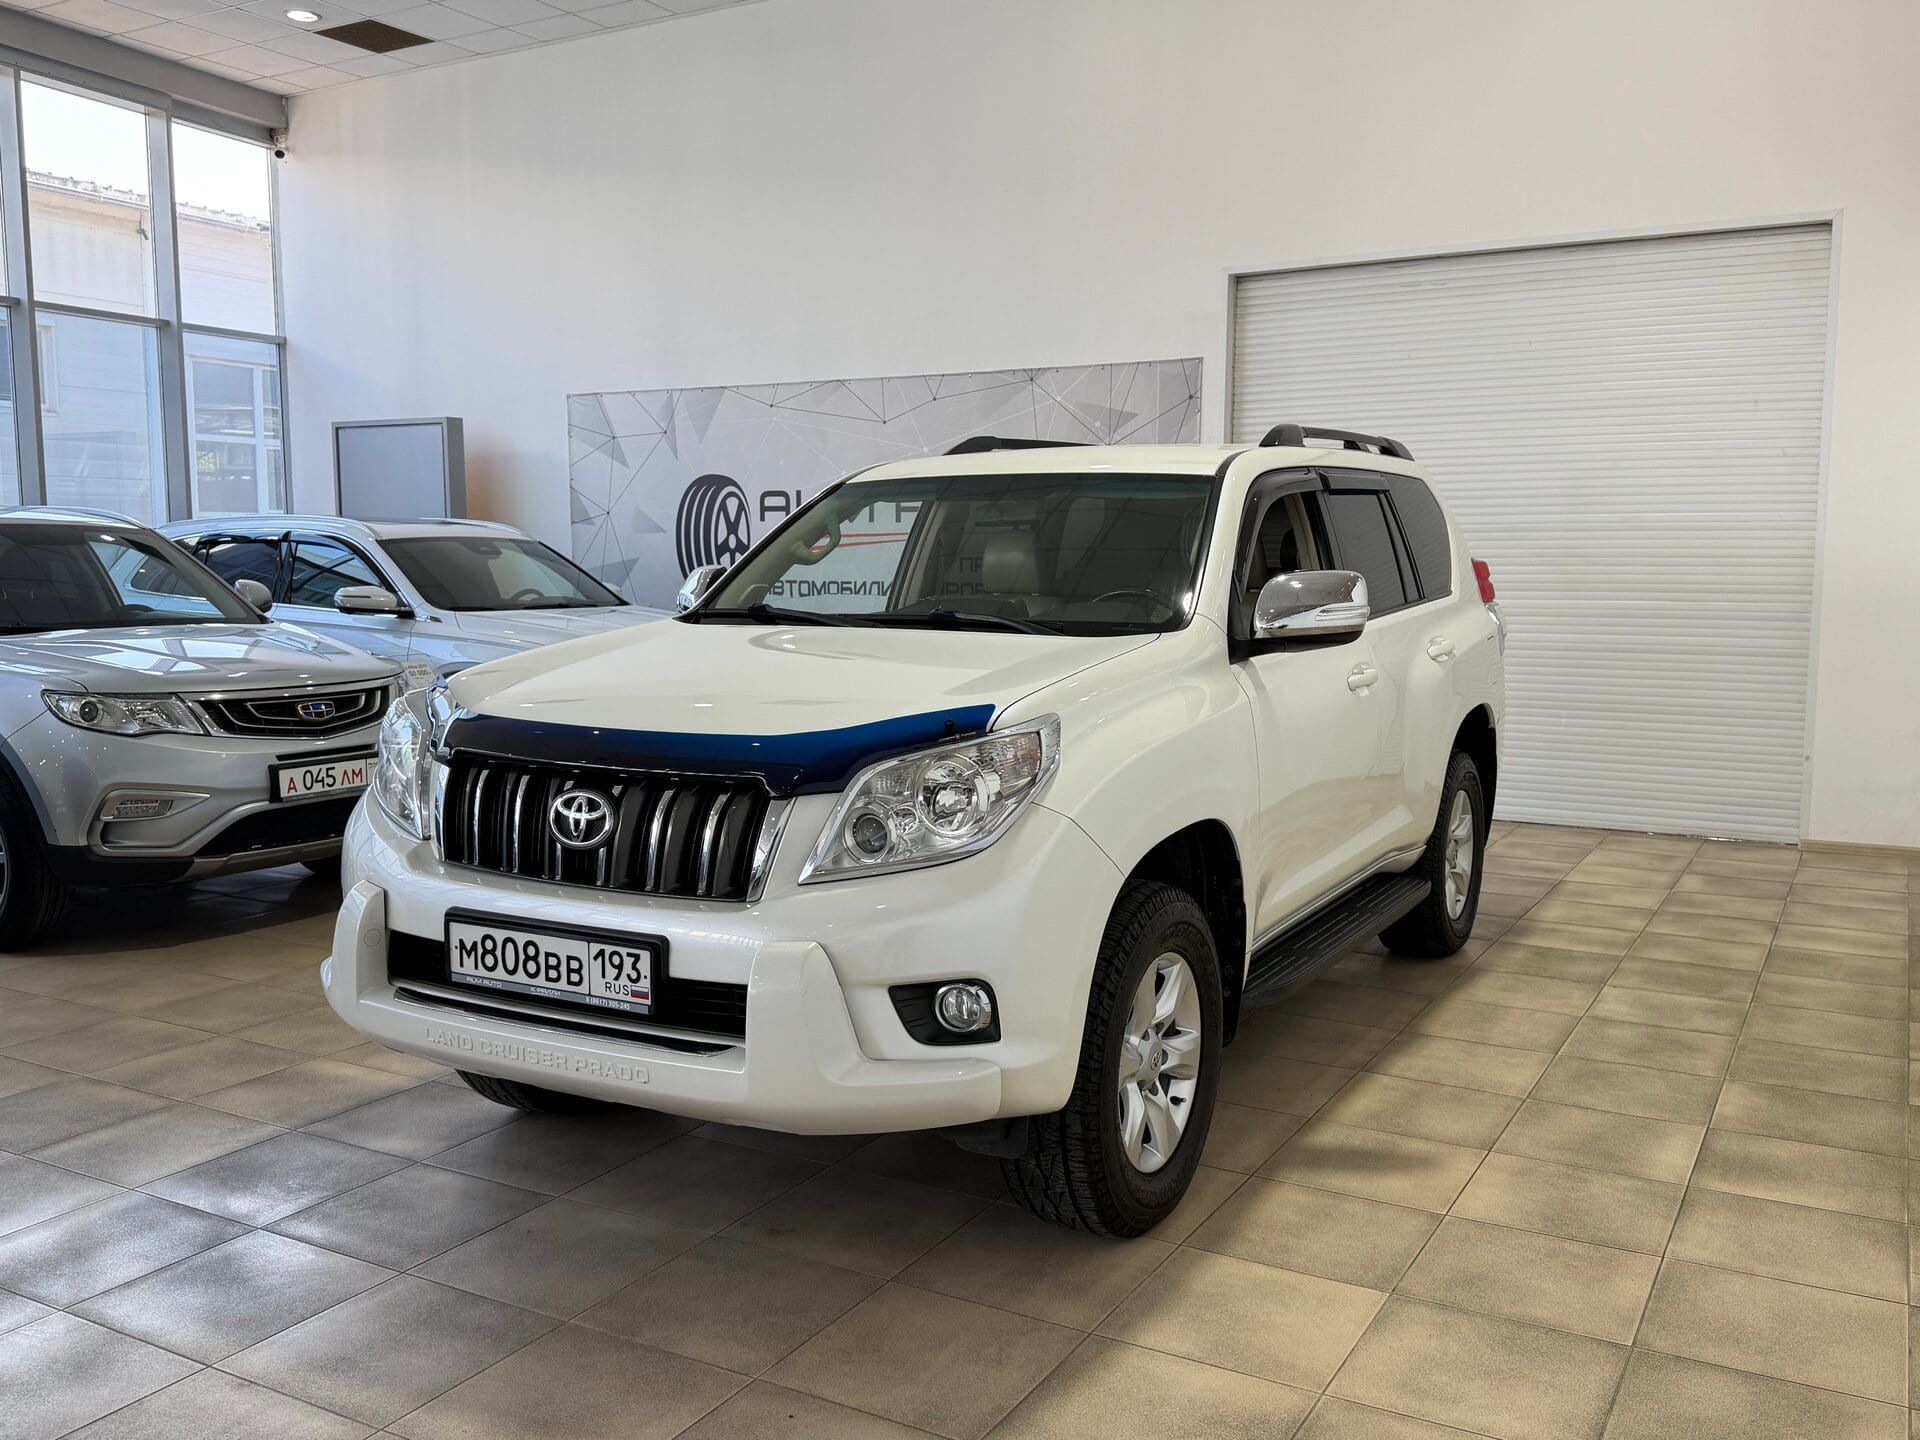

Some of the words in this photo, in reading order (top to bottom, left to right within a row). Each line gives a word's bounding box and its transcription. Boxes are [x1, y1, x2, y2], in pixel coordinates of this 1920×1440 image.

[302, 766, 337, 791] 045
[592, 948, 643, 984] 193
[604, 981, 630, 996] RUS
[424, 1027, 474, 1050] LAND
[479, 1038, 568, 1070] CRUISER
[575, 1056, 650, 1084] PRADO
